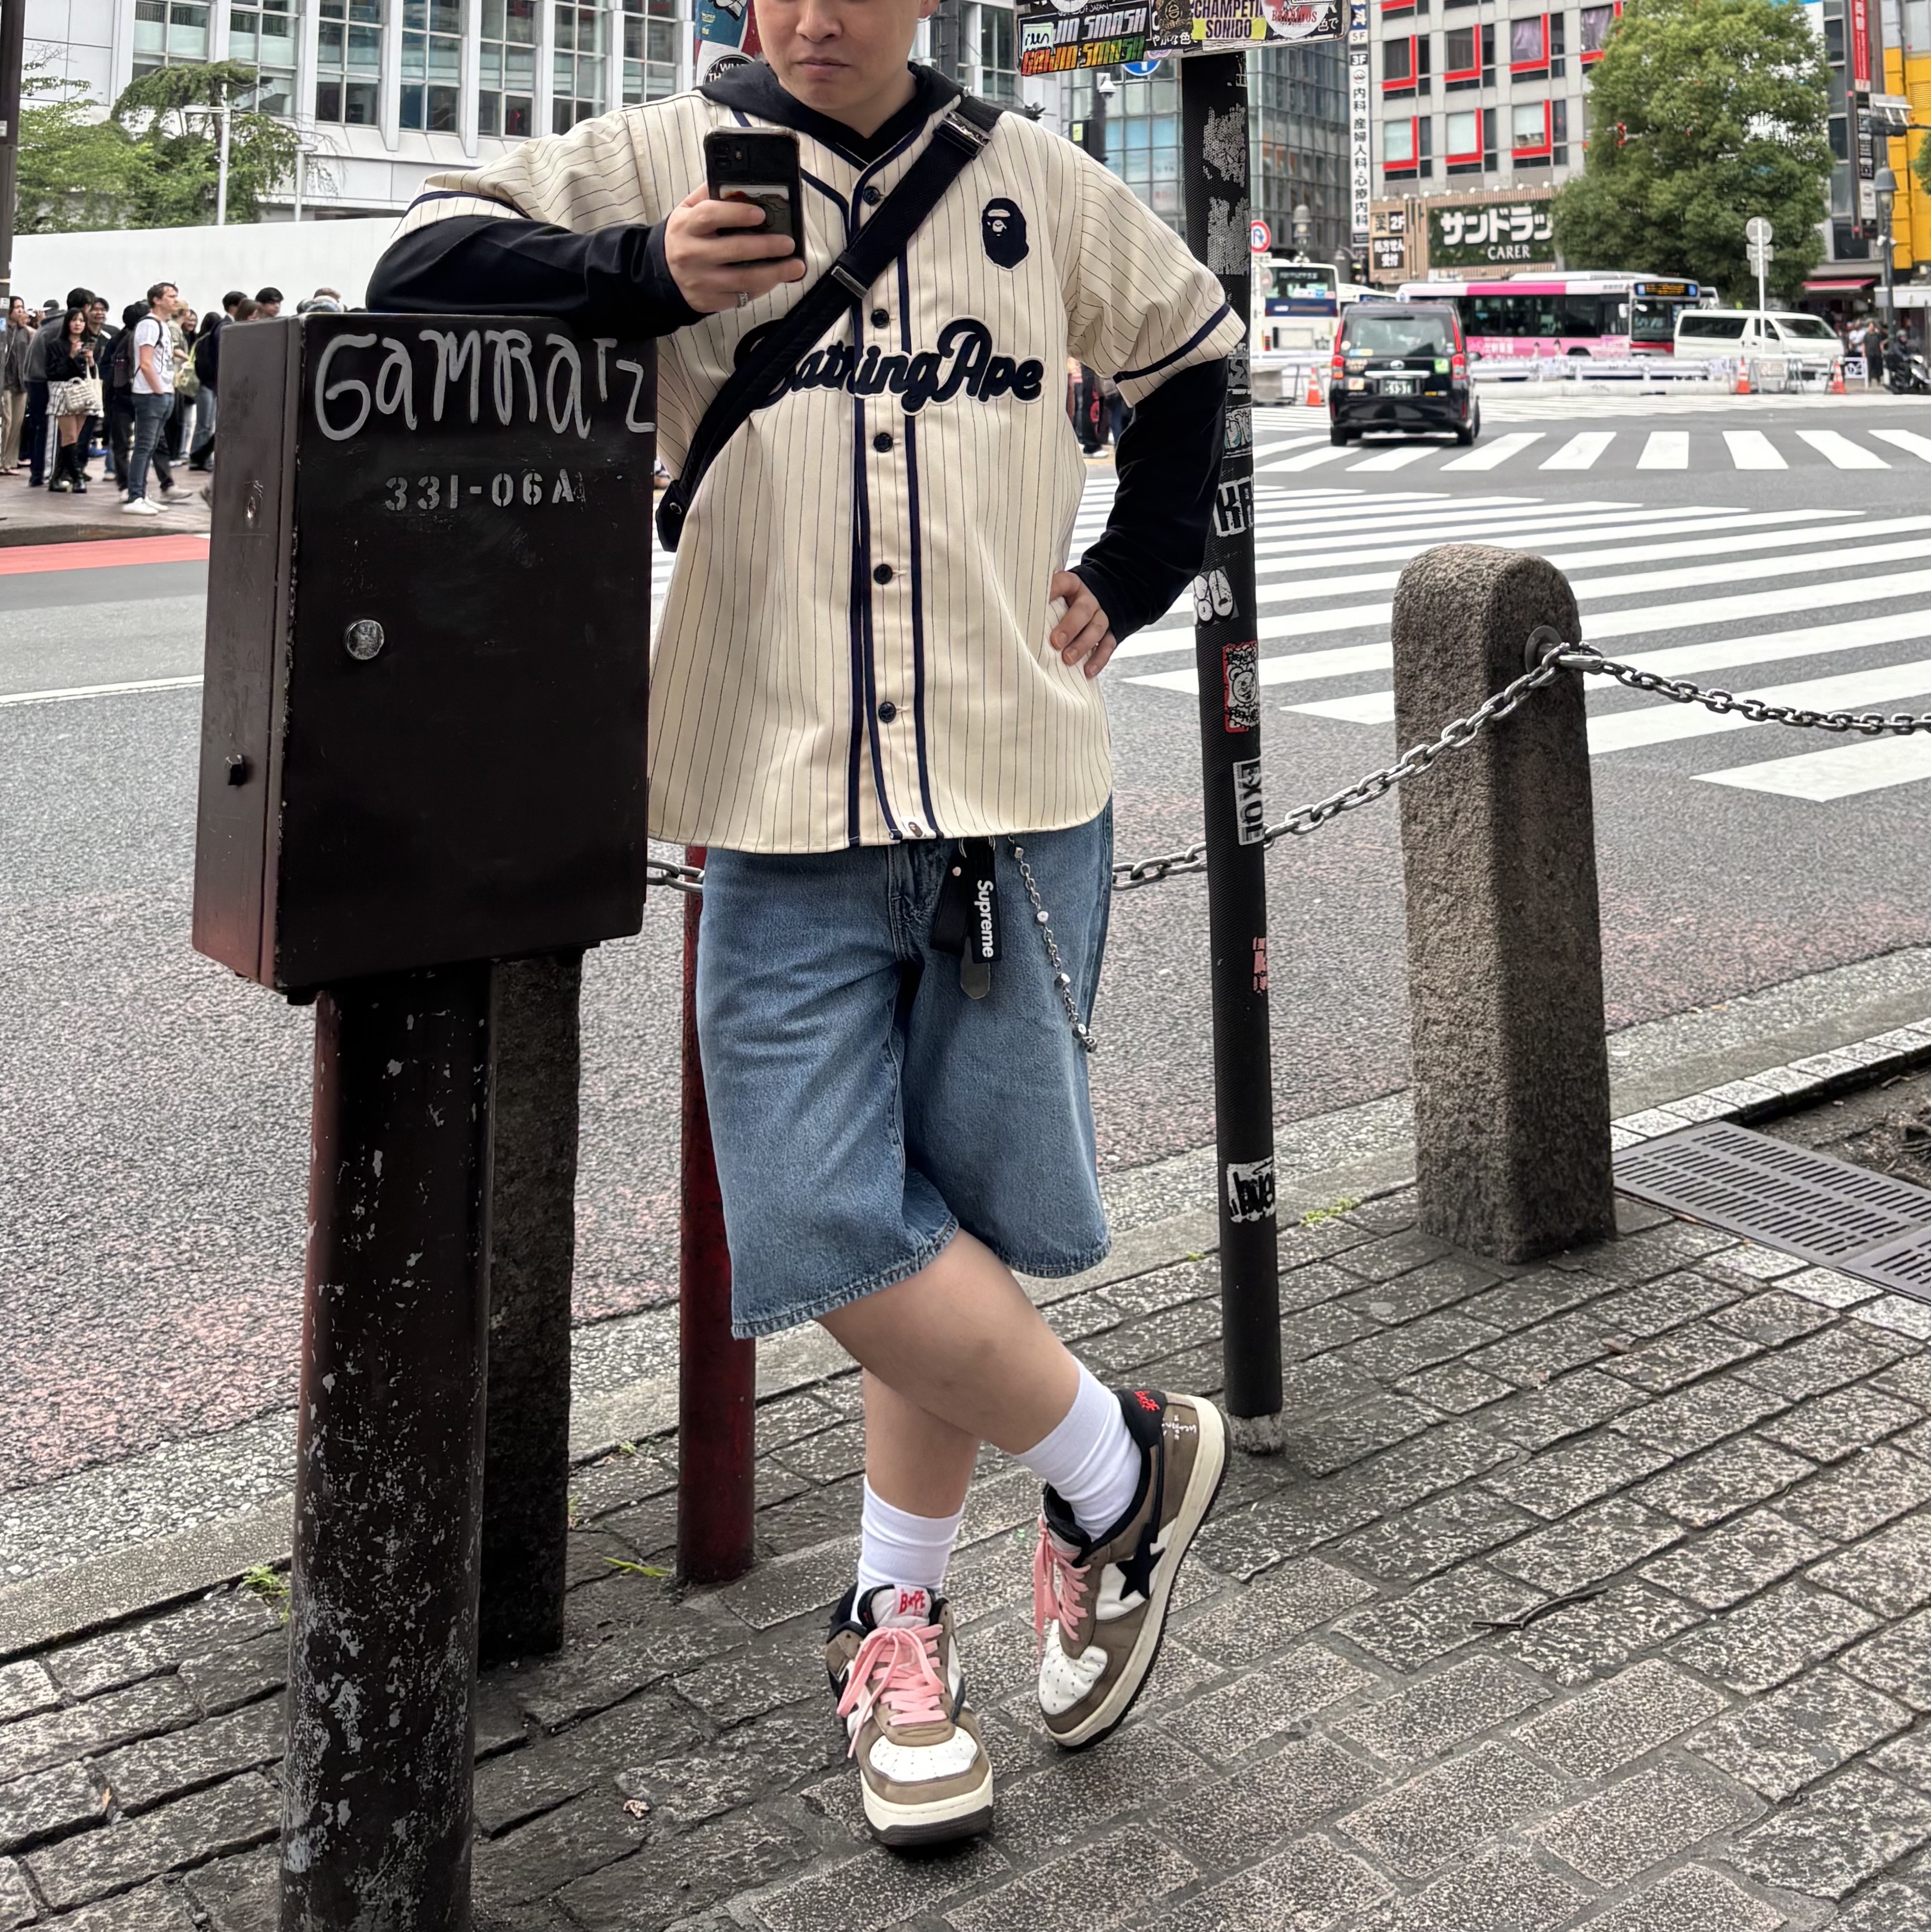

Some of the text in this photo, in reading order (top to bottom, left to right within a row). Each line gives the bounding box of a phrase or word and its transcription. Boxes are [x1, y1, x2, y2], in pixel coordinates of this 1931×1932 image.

[1081, 7, 1147, 40] SMASH
[1205, 19, 1252, 39] SONIDO
[1079, 35, 1145, 69] SMASH
[1351, 55, 1367, 66] 3F
[1353, 88, 1366, 112] 内科
[1390, 215, 1406, 230] 2F
[1487, 244, 1531, 260] CARER
[937, 316, 1045, 403] Ape
[385, 469, 575, 511] 331-06A
[974, 879, 994, 957] Supreme
